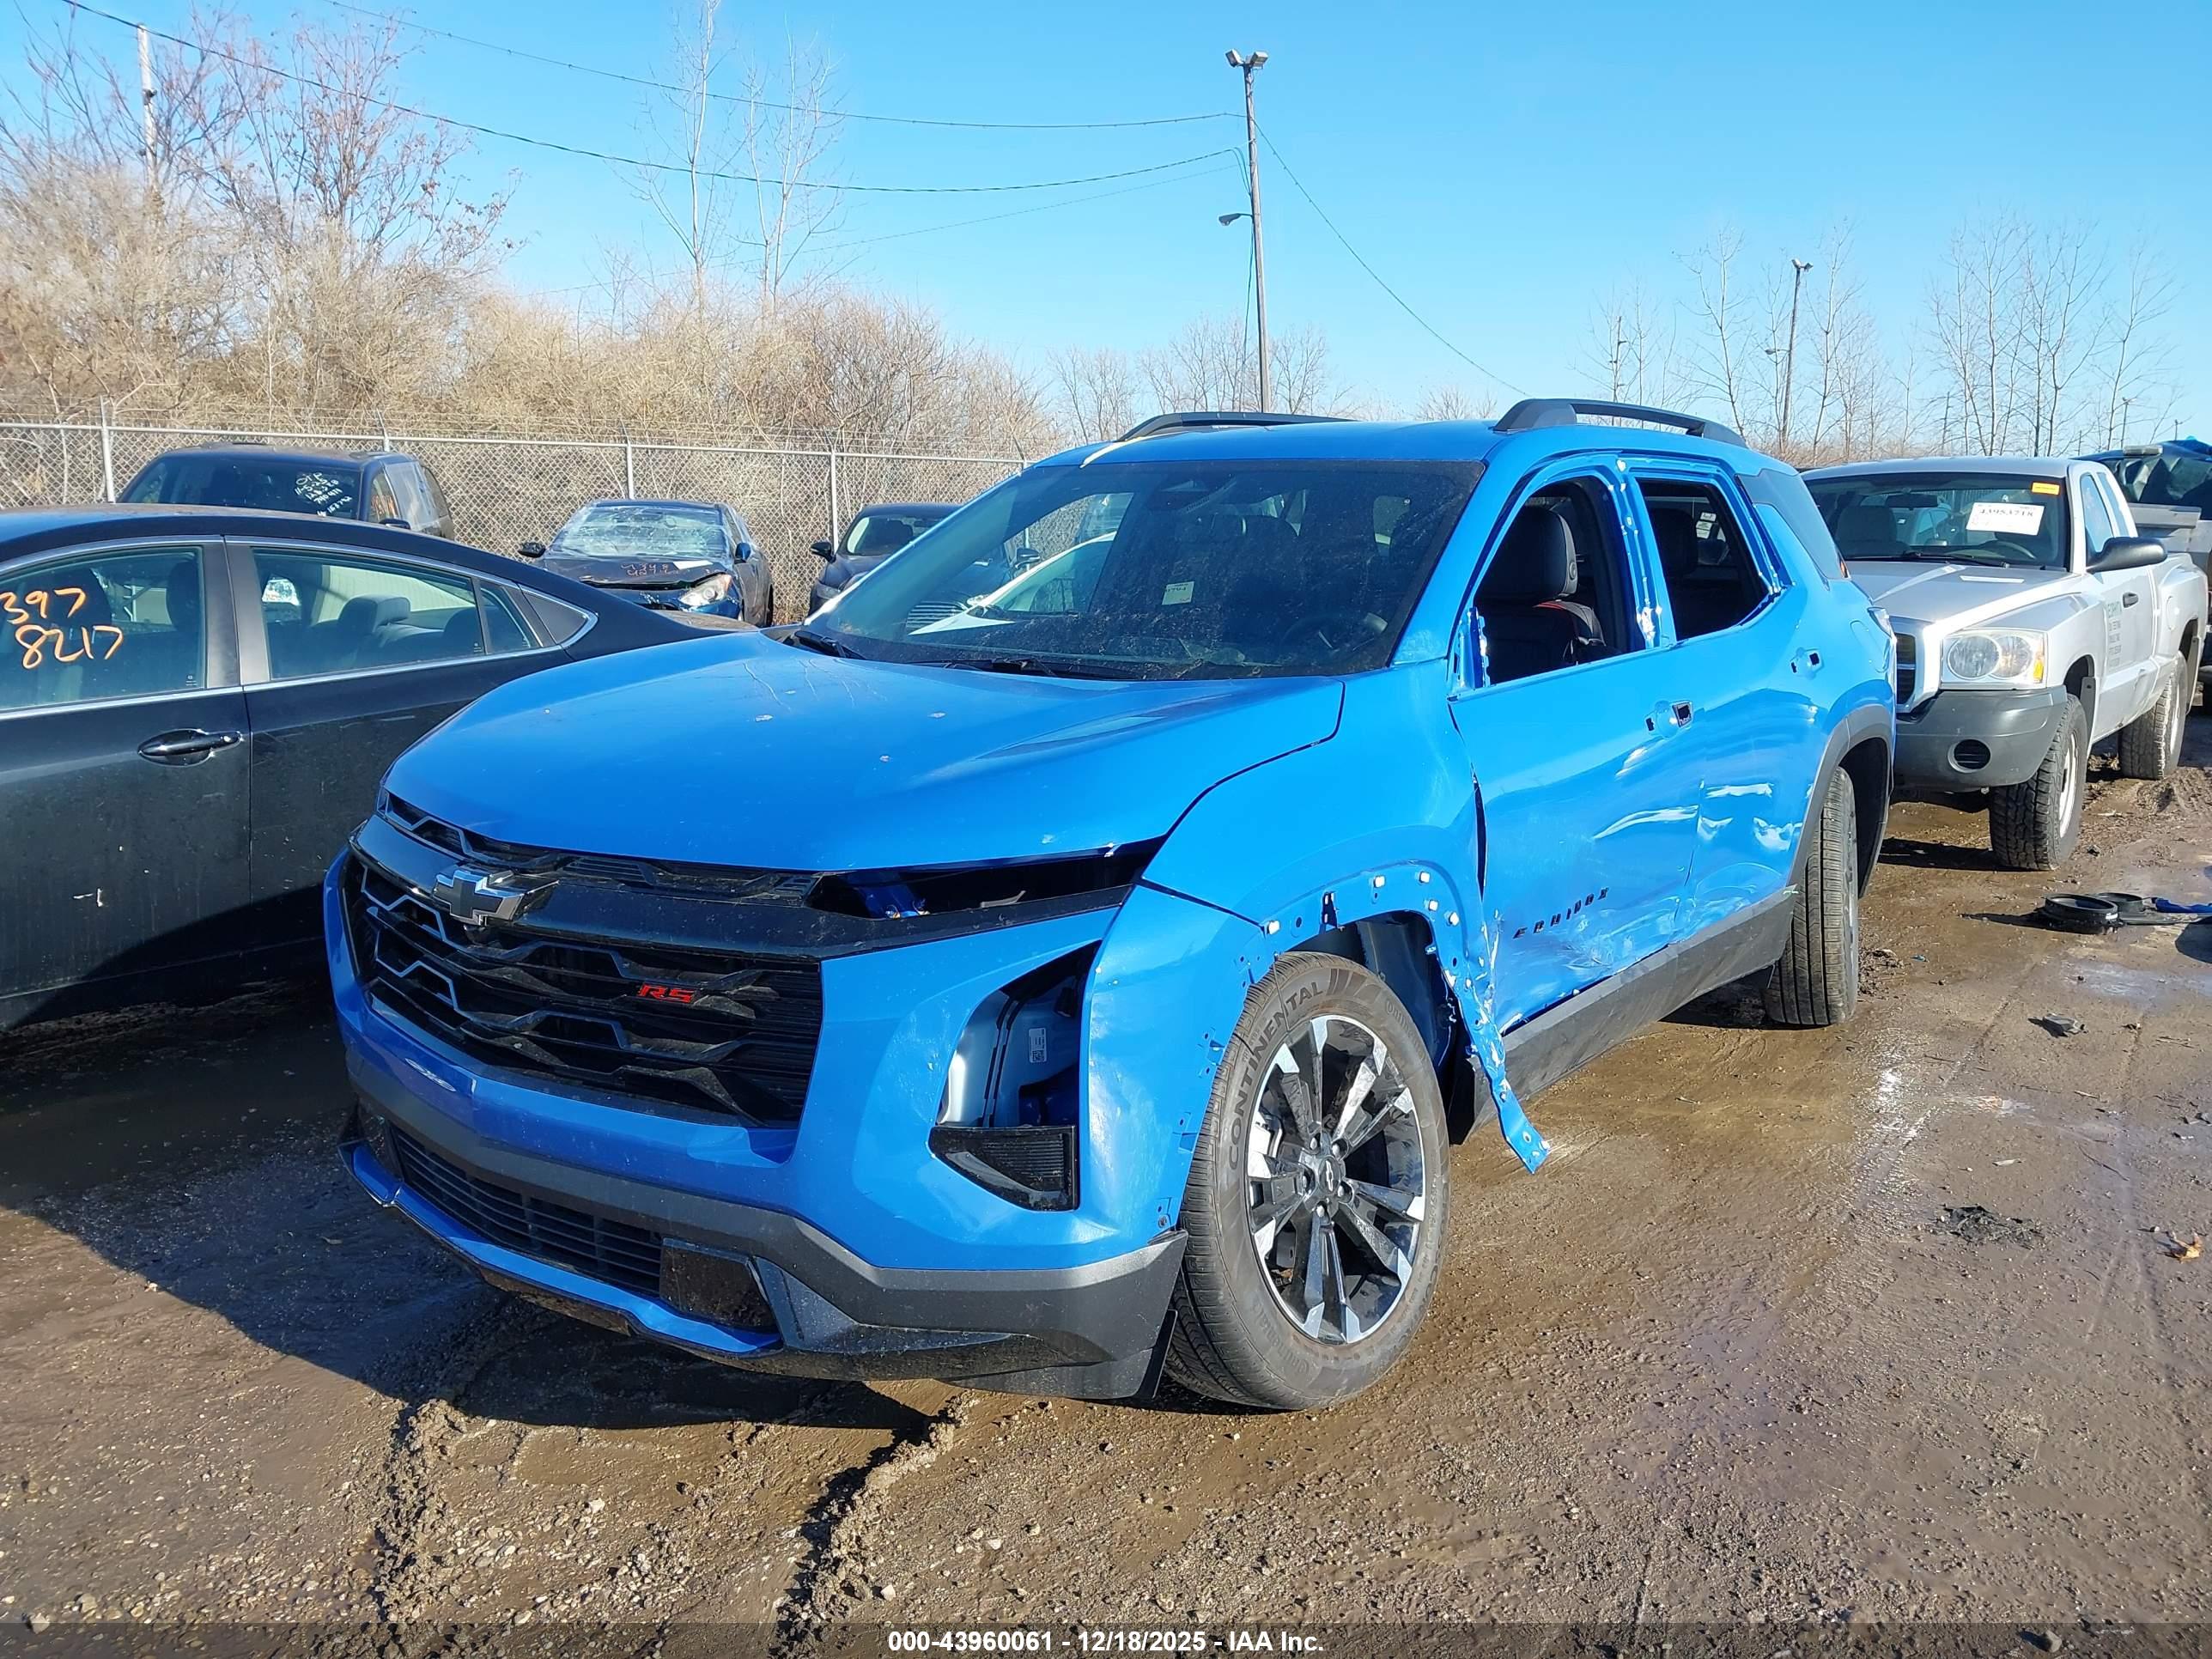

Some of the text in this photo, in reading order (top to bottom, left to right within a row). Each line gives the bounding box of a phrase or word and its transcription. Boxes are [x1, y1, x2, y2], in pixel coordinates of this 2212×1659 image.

[15, 624, 124, 669] 8217
[639, 984, 695, 1003] RS
[1230, 981, 1324, 1170] CONTINENTAL
